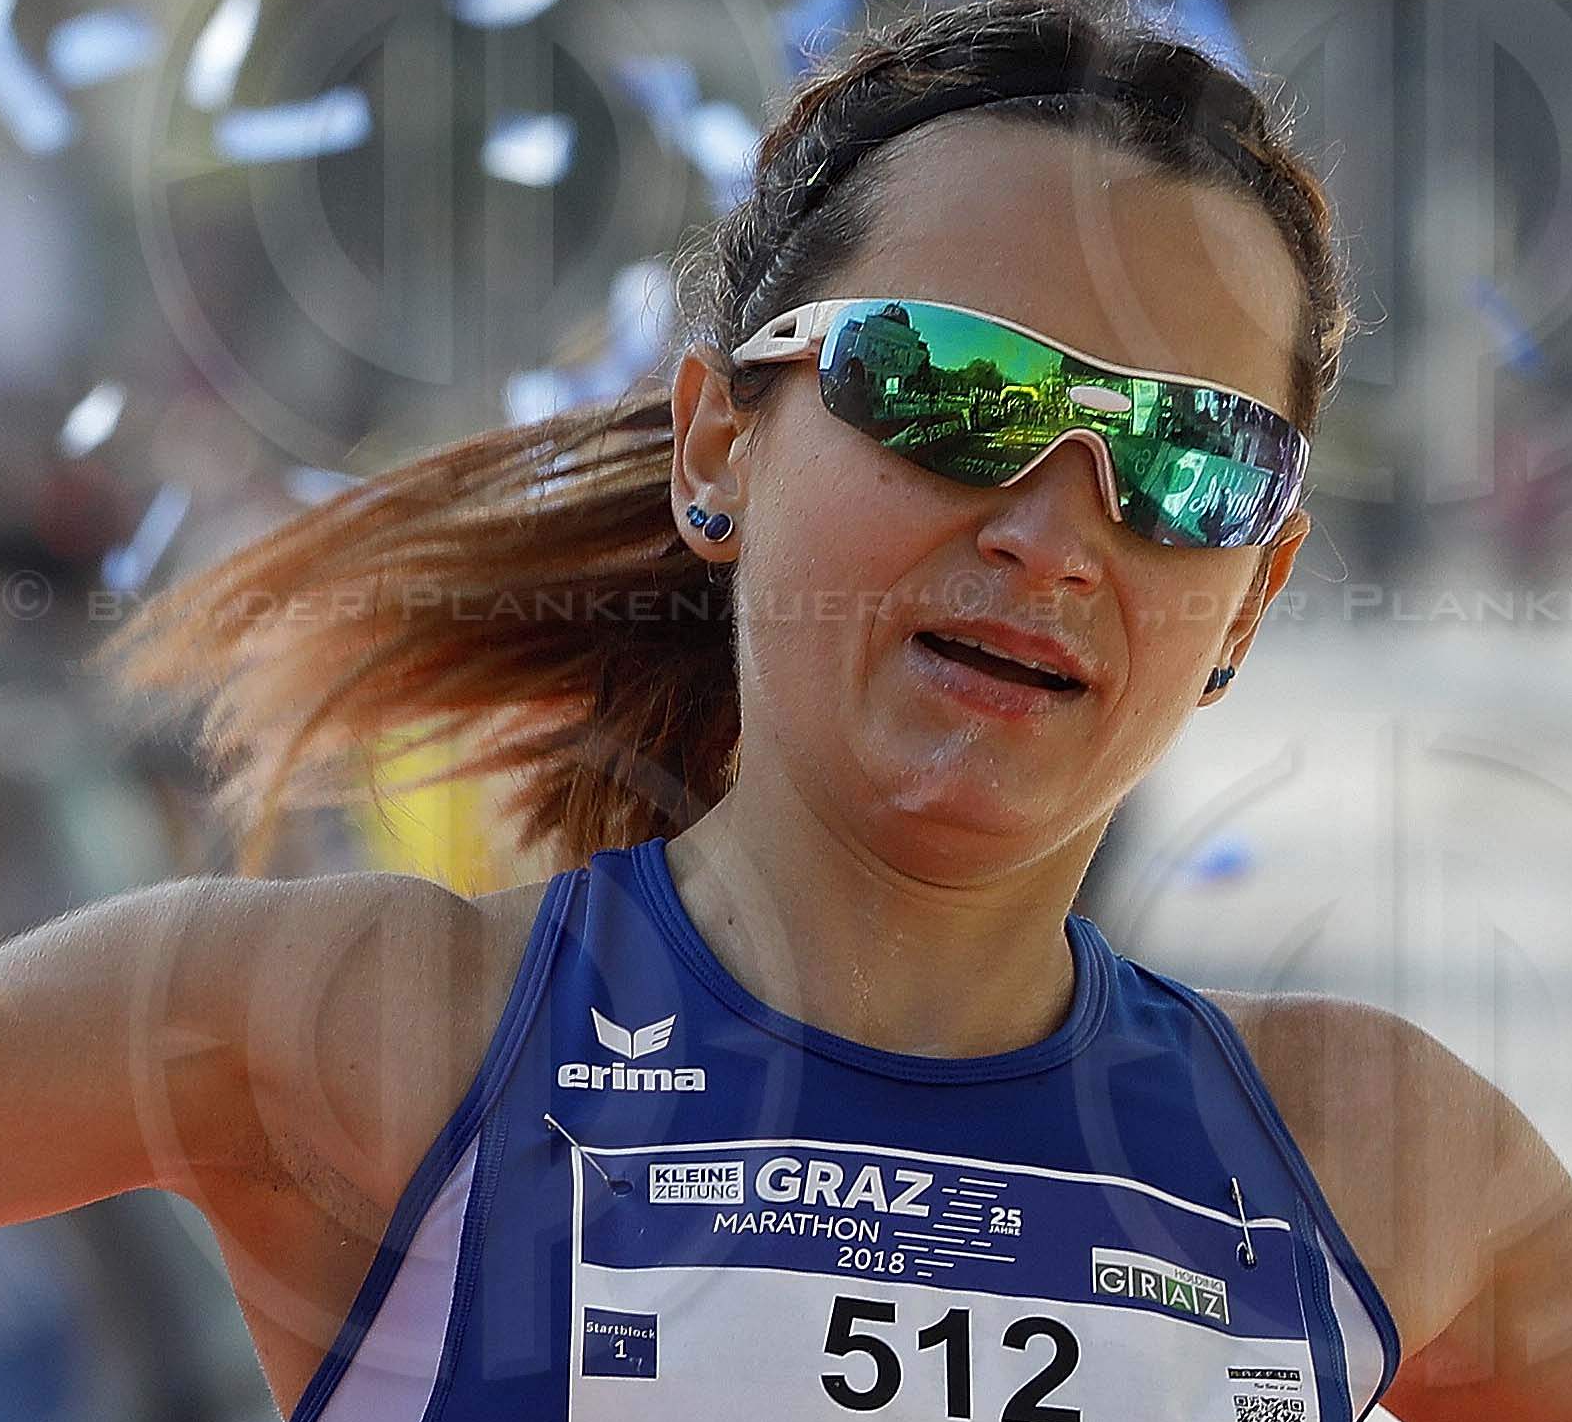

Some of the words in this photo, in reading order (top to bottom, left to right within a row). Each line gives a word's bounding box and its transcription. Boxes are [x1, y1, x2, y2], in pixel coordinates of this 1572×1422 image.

[557, 1062, 706, 1092] erima
[654, 1166, 739, 1183] KLEINE
[654, 1183, 739, 1200] ZEITUNG
[755, 1156, 934, 1218] GRAZ
[712, 1211, 880, 1243] MARATHON
[990, 1206, 1022, 1228] 25
[988, 1225, 1022, 1237] JAHRE
[836, 1246, 905, 1273] 2018
[1099, 1267, 1222, 1319] GRAZ
[585, 1321, 656, 1339] Startblock
[614, 1339, 628, 1359] 1
